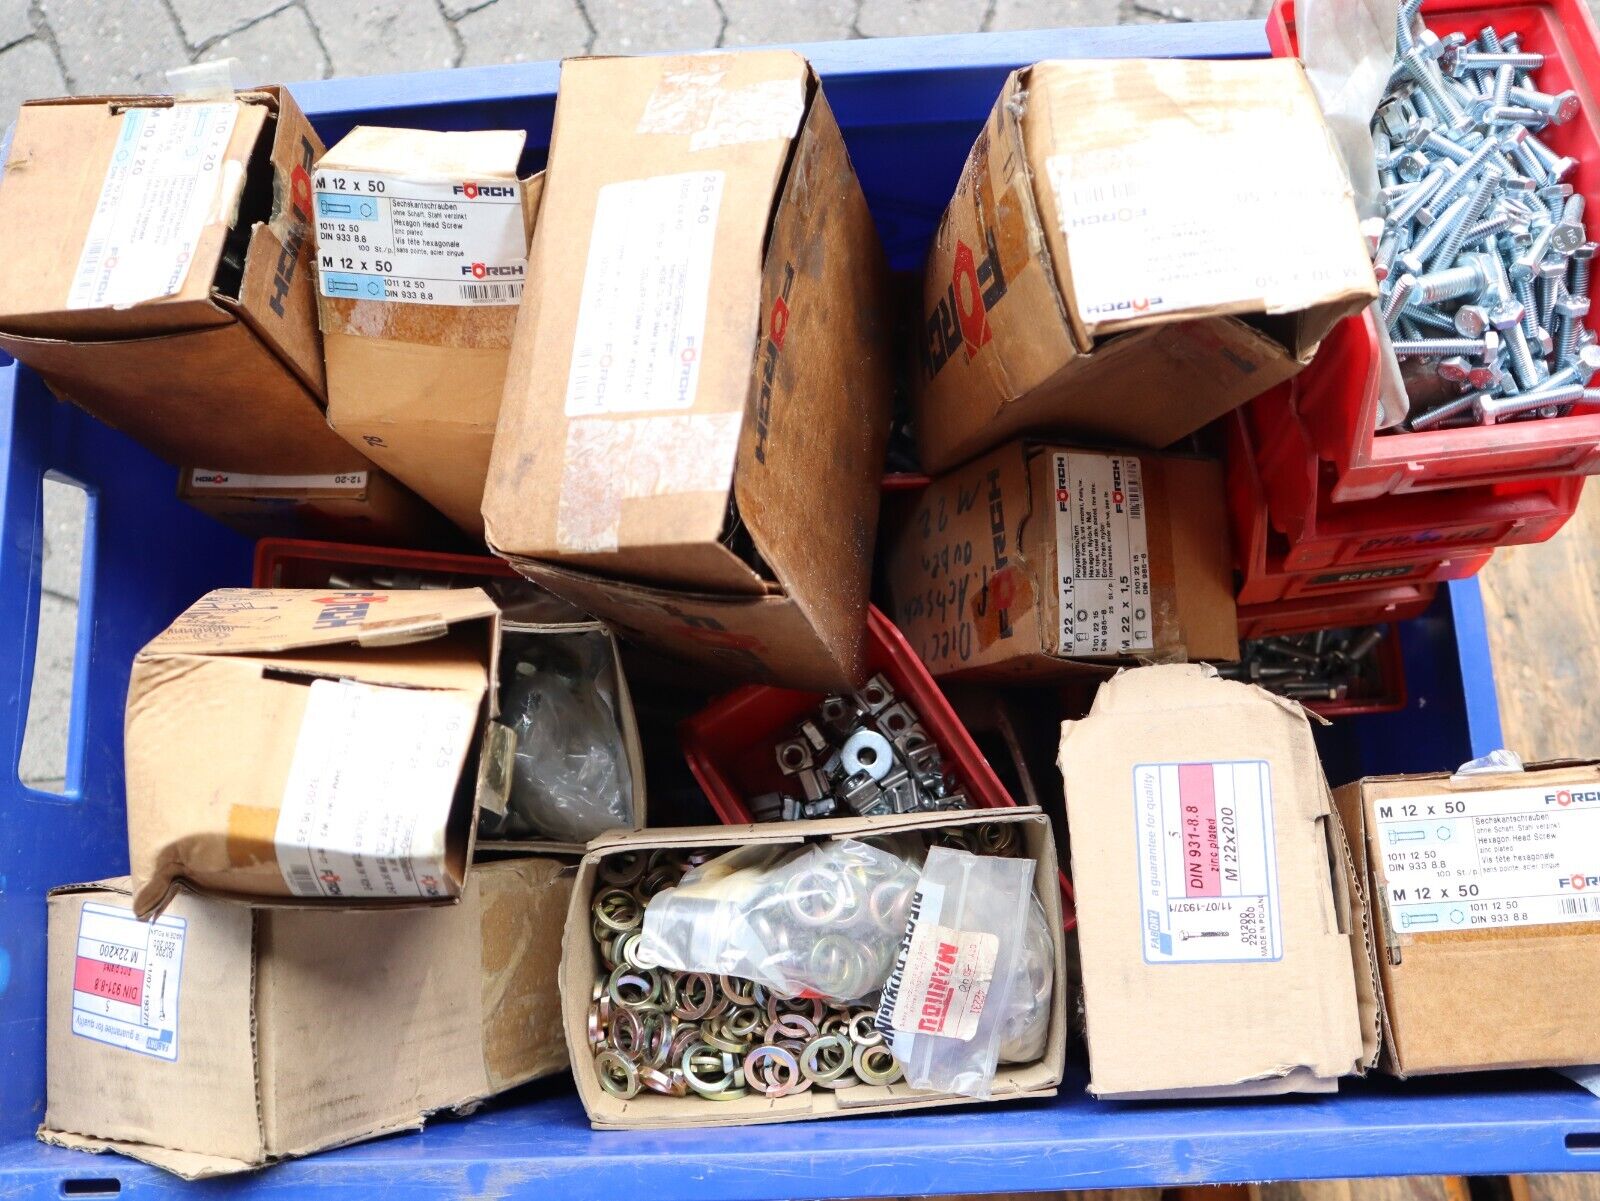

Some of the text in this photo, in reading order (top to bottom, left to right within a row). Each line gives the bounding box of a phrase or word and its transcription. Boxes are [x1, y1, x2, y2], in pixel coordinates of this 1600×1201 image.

[143, 125, 156, 138] 10
[132, 160, 145, 176] 20
[203, 154, 216, 172] 20
[316, 177, 325, 189] M
[333, 179, 345, 190] 12
[354, 181, 360, 191] x
[369, 181, 385, 192] 50
[320, 223, 335, 231] 1011
[338, 224, 346, 232] 12
[394, 219, 463, 230] Hexagon Head Screw
[336, 233, 351, 242] 933
[354, 235, 367, 243] 8.8
[396, 237, 405, 245] Vis
[422, 240, 460, 249] hexagonale
[323, 256, 393, 272] M 12 x 50
[384, 279, 425, 289] 1011 12 50
[385, 289, 433, 301] DIN 933 8.8
[334, 475, 361, 484] 12-20
[1133, 554, 1138, 562] 15
[1133, 566, 1139, 575] 22
[1063, 576, 1073, 594] 1,5
[1119, 575, 1129, 593] 1,5
[1092, 610, 1098, 619] 15
[1064, 617, 1073, 634] 22
[1093, 622, 1099, 631] 22
[1121, 616, 1129, 632] 22
[1063, 642, 1073, 652] M
[1121, 640, 1130, 649] M
[1144, 773, 1155, 809] quality
[1380, 806, 1393, 818] M
[1401, 805, 1417, 817] 12
[1427, 806, 1435, 815] x
[1445, 801, 1465, 814] 50
[1147, 812, 1155, 827] for
[1206, 819, 1220, 872] zinc plated
[1222, 807, 1238, 881] M 22x200
[1478, 836, 1510, 845] Hexagon
[1534, 833, 1556, 841] Screw
[1186, 806, 1203, 888] DIN 931-8.8
[1148, 832, 1160, 886] guarantee
[1388, 851, 1436, 860] 1011 12 50
[1482, 856, 1494, 864] Vis
[1513, 853, 1554, 862] hexagonale
[1389, 860, 1446, 872] DIN 933 8.8
[1393, 884, 1479, 901] M 12 x 50
[1470, 901, 1518, 911] 1011 12 50
[1471, 913, 1528, 924] DIN 933 8.8
[100, 944, 138, 963] M 22x200
[122, 985, 138, 999] DIN
[76, 1015, 94, 1028] quality
[95, 1023, 104, 1031] for
[105, 1024, 134, 1039] guarantee
